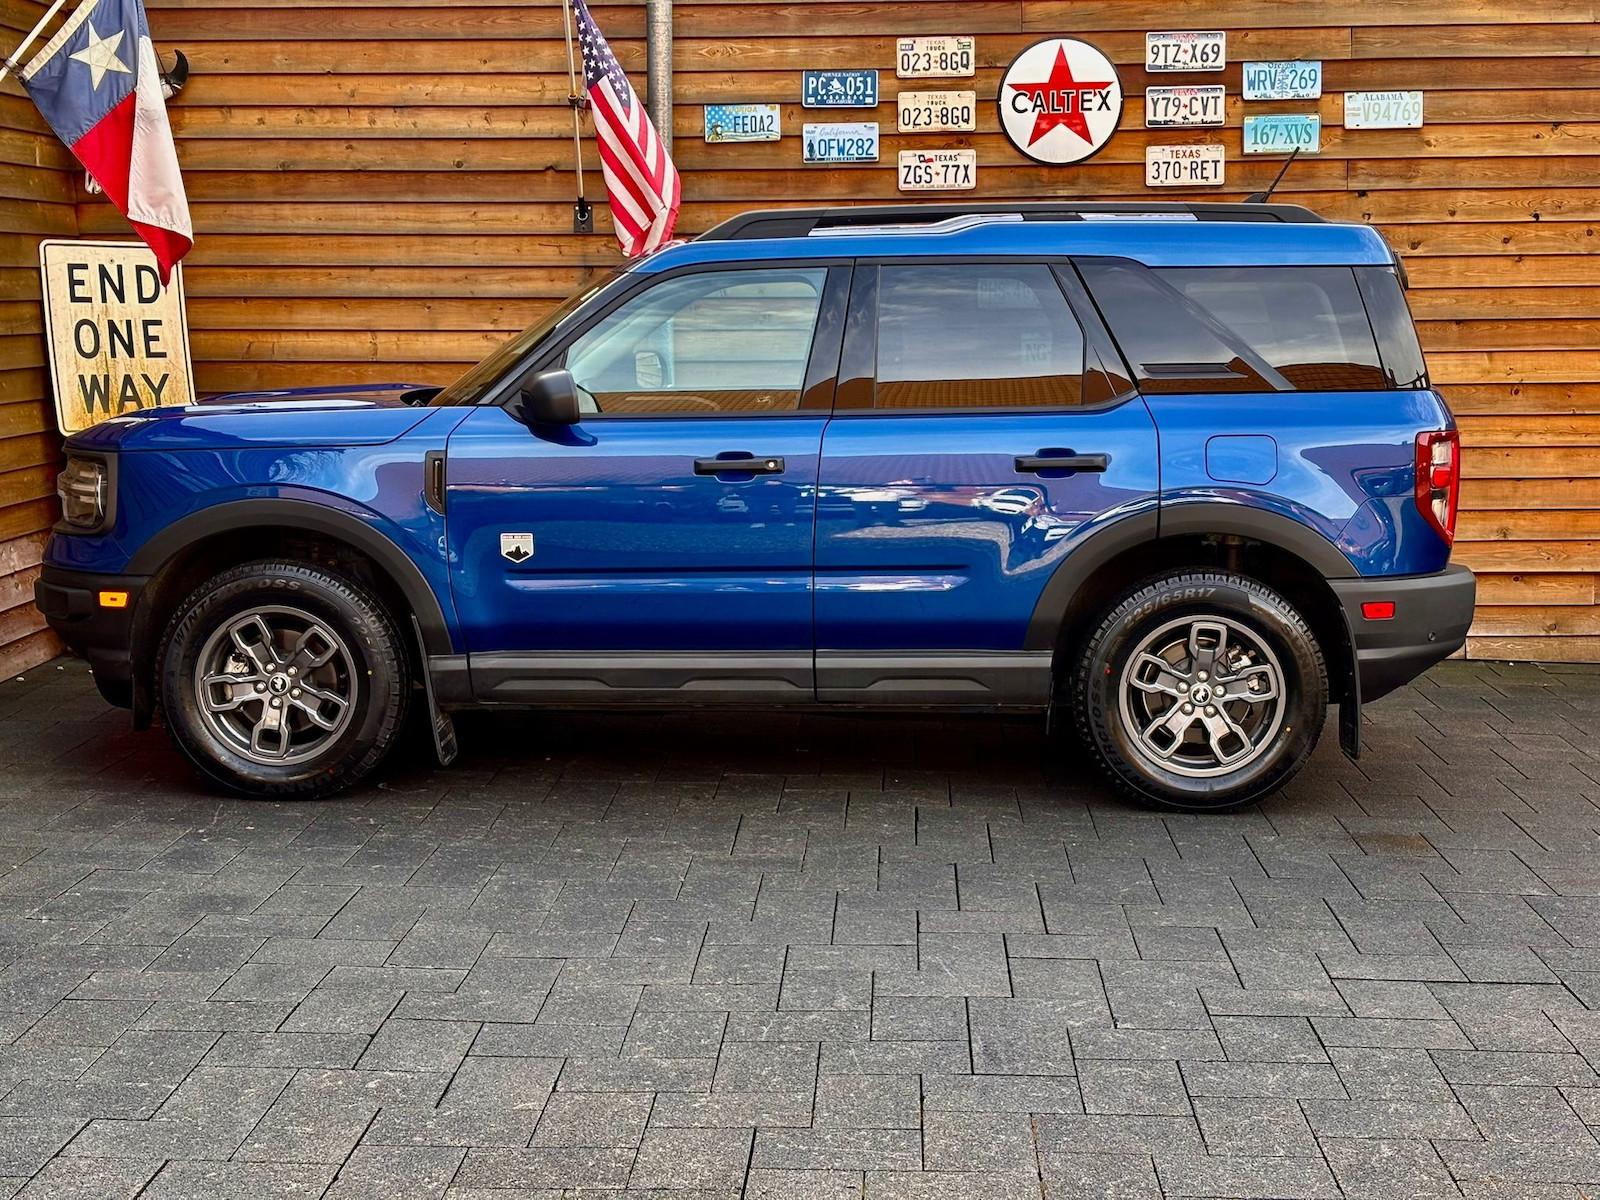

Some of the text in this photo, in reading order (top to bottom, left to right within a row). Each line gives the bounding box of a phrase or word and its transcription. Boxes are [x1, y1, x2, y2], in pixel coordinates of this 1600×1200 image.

[901, 51, 969, 71] 023 8GQ
[1151, 43, 1220, 63] 9TZ X69
[808, 76, 874, 95] PC 051
[1246, 68, 1318, 91] WRV 269
[1011, 90, 1112, 114] CALTEX
[1151, 96, 1221, 117] Y79 CVT
[1363, 93, 1404, 101] ALABAMA
[902, 106, 970, 126] 023 8GQ
[1362, 101, 1421, 121] V94769
[934, 154, 958, 162] TEXAS
[1170, 149, 1201, 159] TEXAS
[903, 164, 971, 184] ZGS 77X
[1152, 160, 1221, 180] 370 RET
[67, 263, 161, 304] END
[74, 318, 167, 360] ONE
[78, 373, 170, 414] WAY
[1124, 587, 1217, 630] 225/65R17
